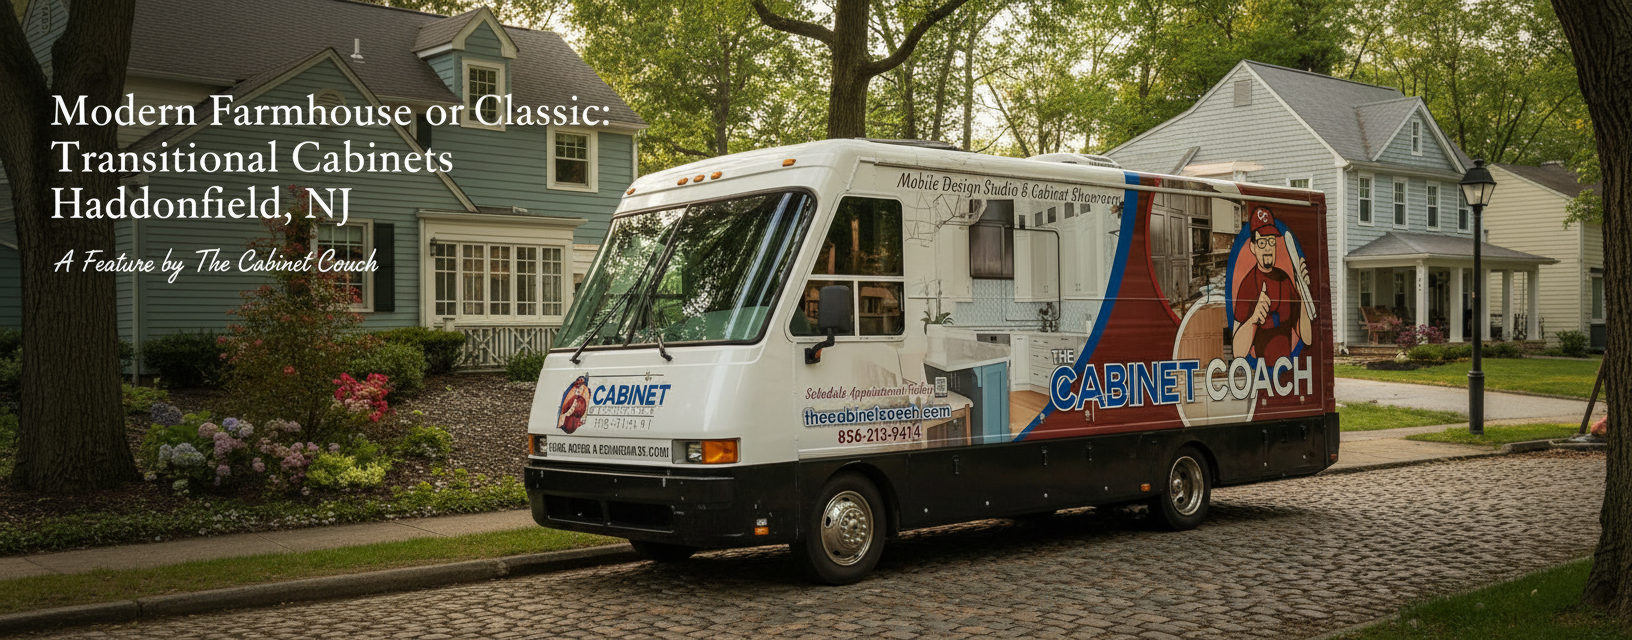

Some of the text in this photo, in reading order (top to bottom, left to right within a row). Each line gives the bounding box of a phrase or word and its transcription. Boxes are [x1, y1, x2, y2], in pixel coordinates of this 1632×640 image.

[897, 172, 940, 191] Mobile
[942, 177, 981, 197] Design
[983, 180, 1018, 197] Studio
[1051, 349, 1075, 365] THE
[1050, 355, 1314, 412] CABINET COACH
[592, 384, 672, 406] CABINET
[838, 425, 922, 444] 856-213-9414
